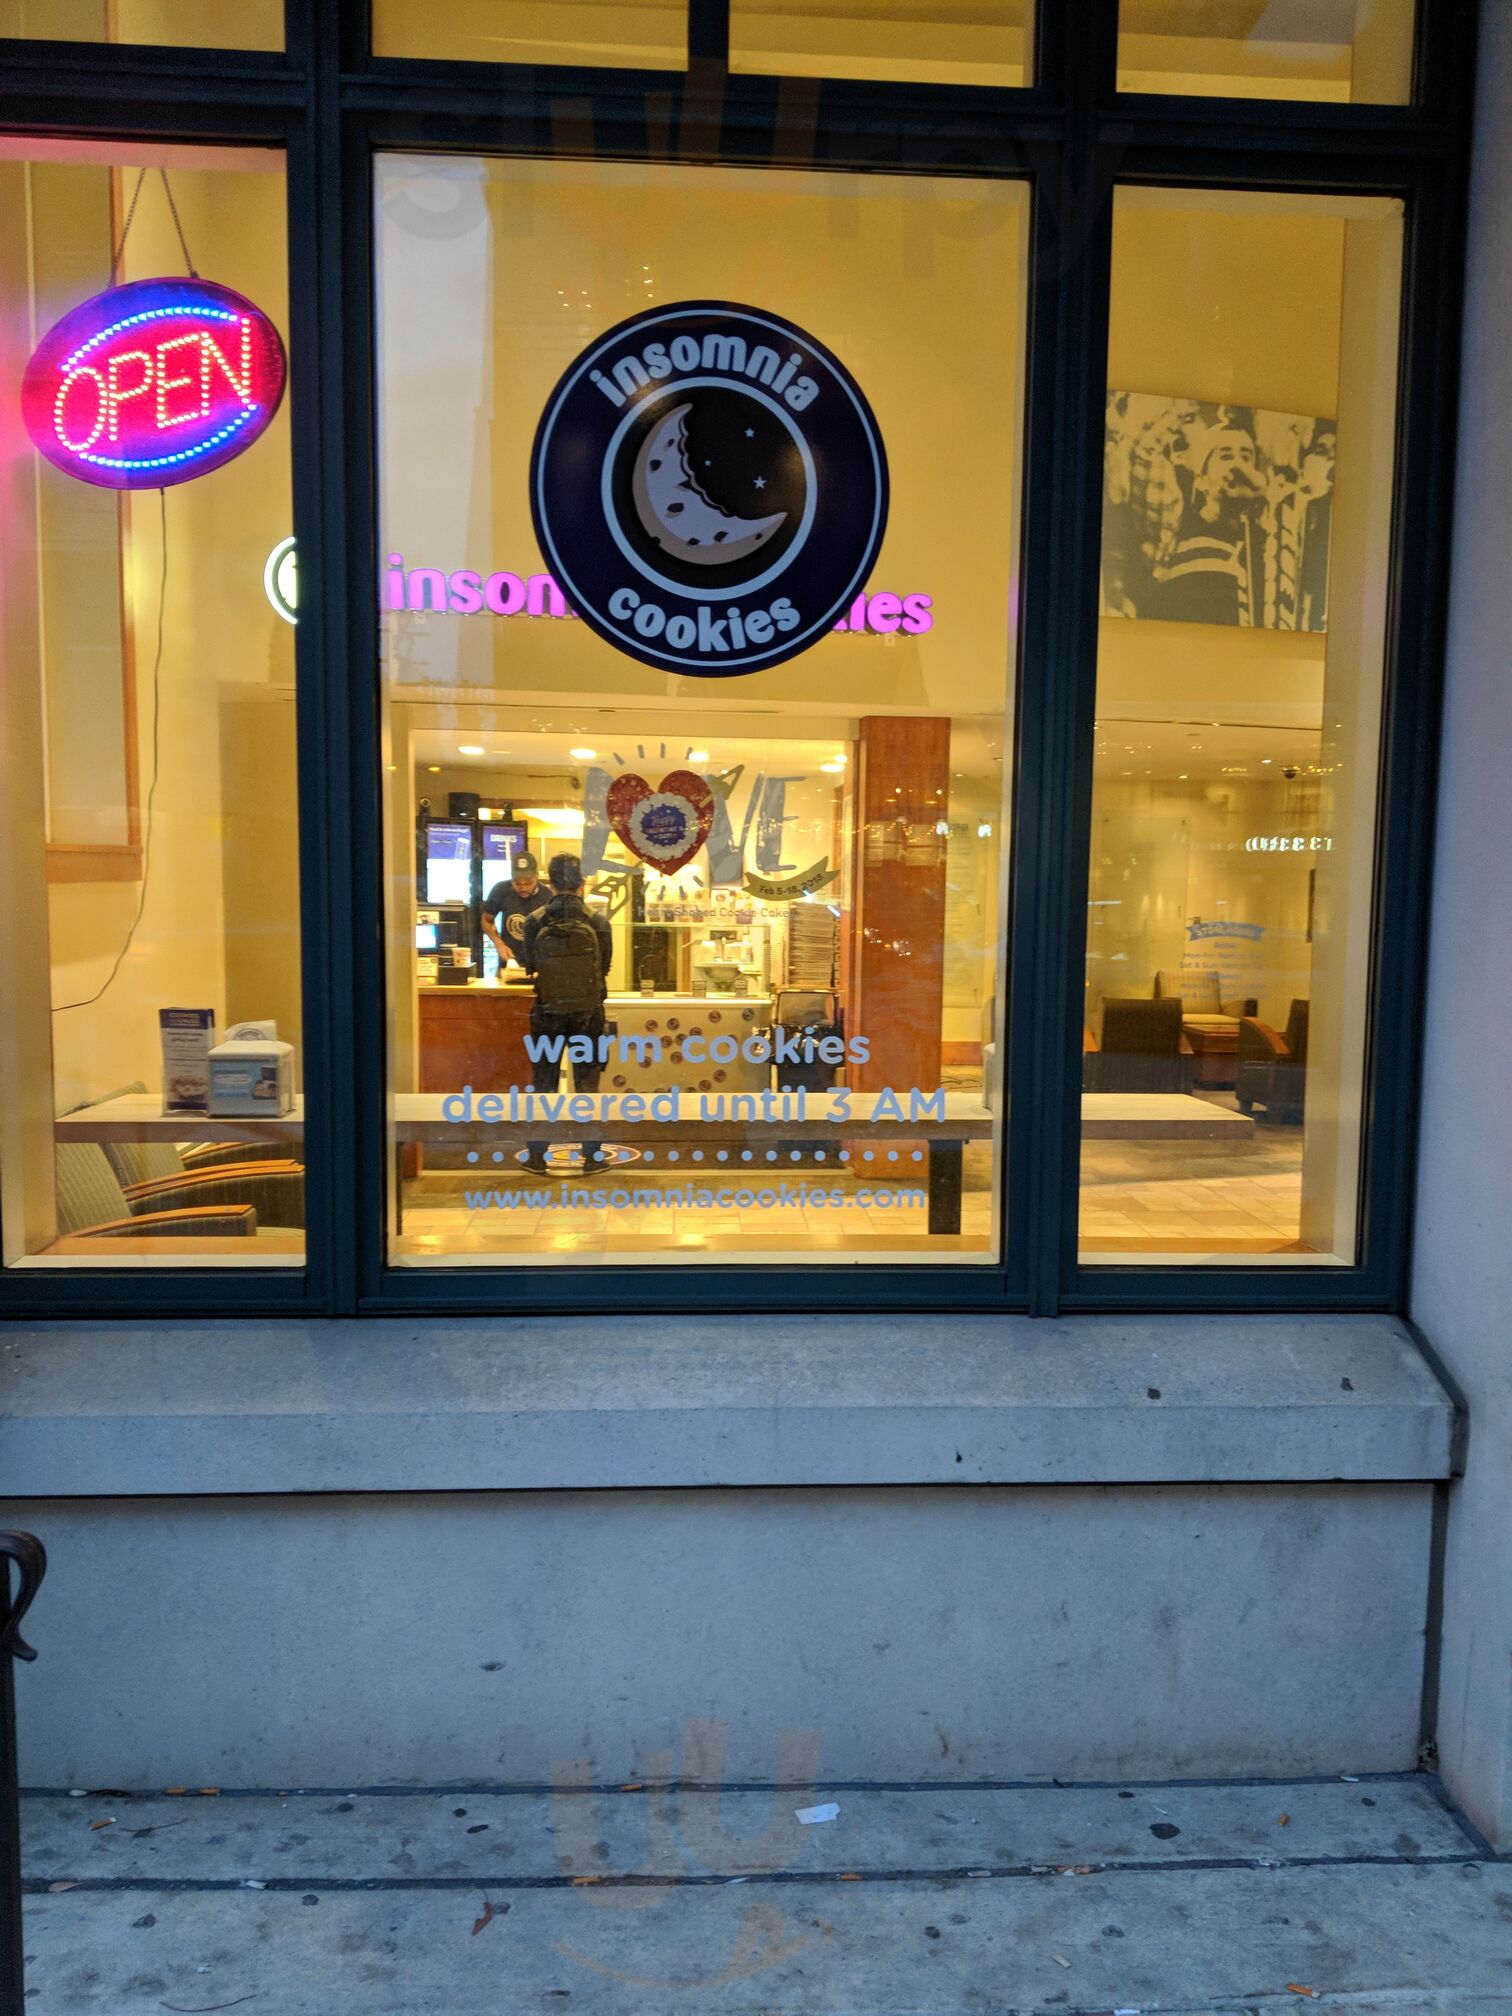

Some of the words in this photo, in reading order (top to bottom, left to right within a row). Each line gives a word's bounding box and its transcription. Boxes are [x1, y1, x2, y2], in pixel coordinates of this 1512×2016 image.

[53, 317, 251, 451] OPEN
[589, 333, 820, 412] insomnia
[608, 587, 801, 652] cookies
[759, 885, 775, 895] Feb
[523, 1033, 661, 1064] warm
[681, 1027, 870, 1064] cookies
[442, 1085, 679, 1123] delivered
[700, 1086, 806, 1122] until
[826, 1087, 852, 1122] 3
[870, 1087, 945, 1122] AM
[465, 1182, 926, 1210] www.insomniacookies.com
